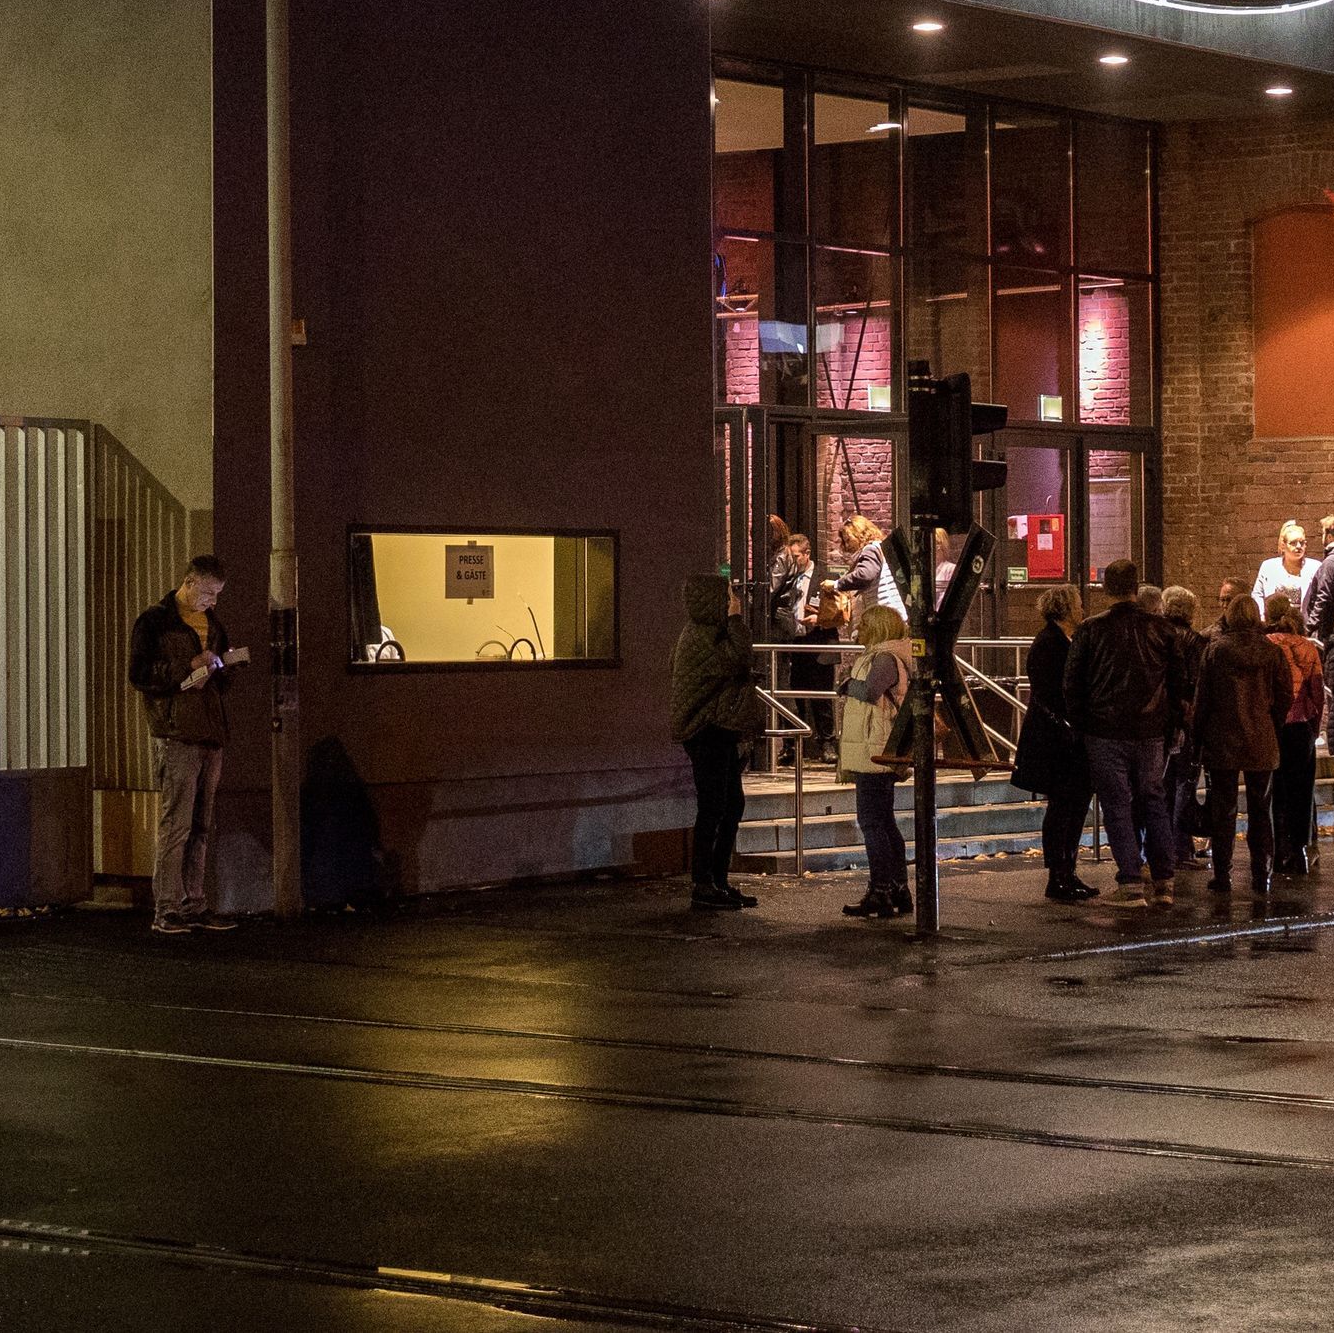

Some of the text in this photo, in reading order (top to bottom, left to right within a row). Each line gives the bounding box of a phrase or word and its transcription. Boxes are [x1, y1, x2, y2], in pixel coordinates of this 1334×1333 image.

[459, 555, 484, 565] PRESSE
[456, 568, 487, 580] & GÄSTE
